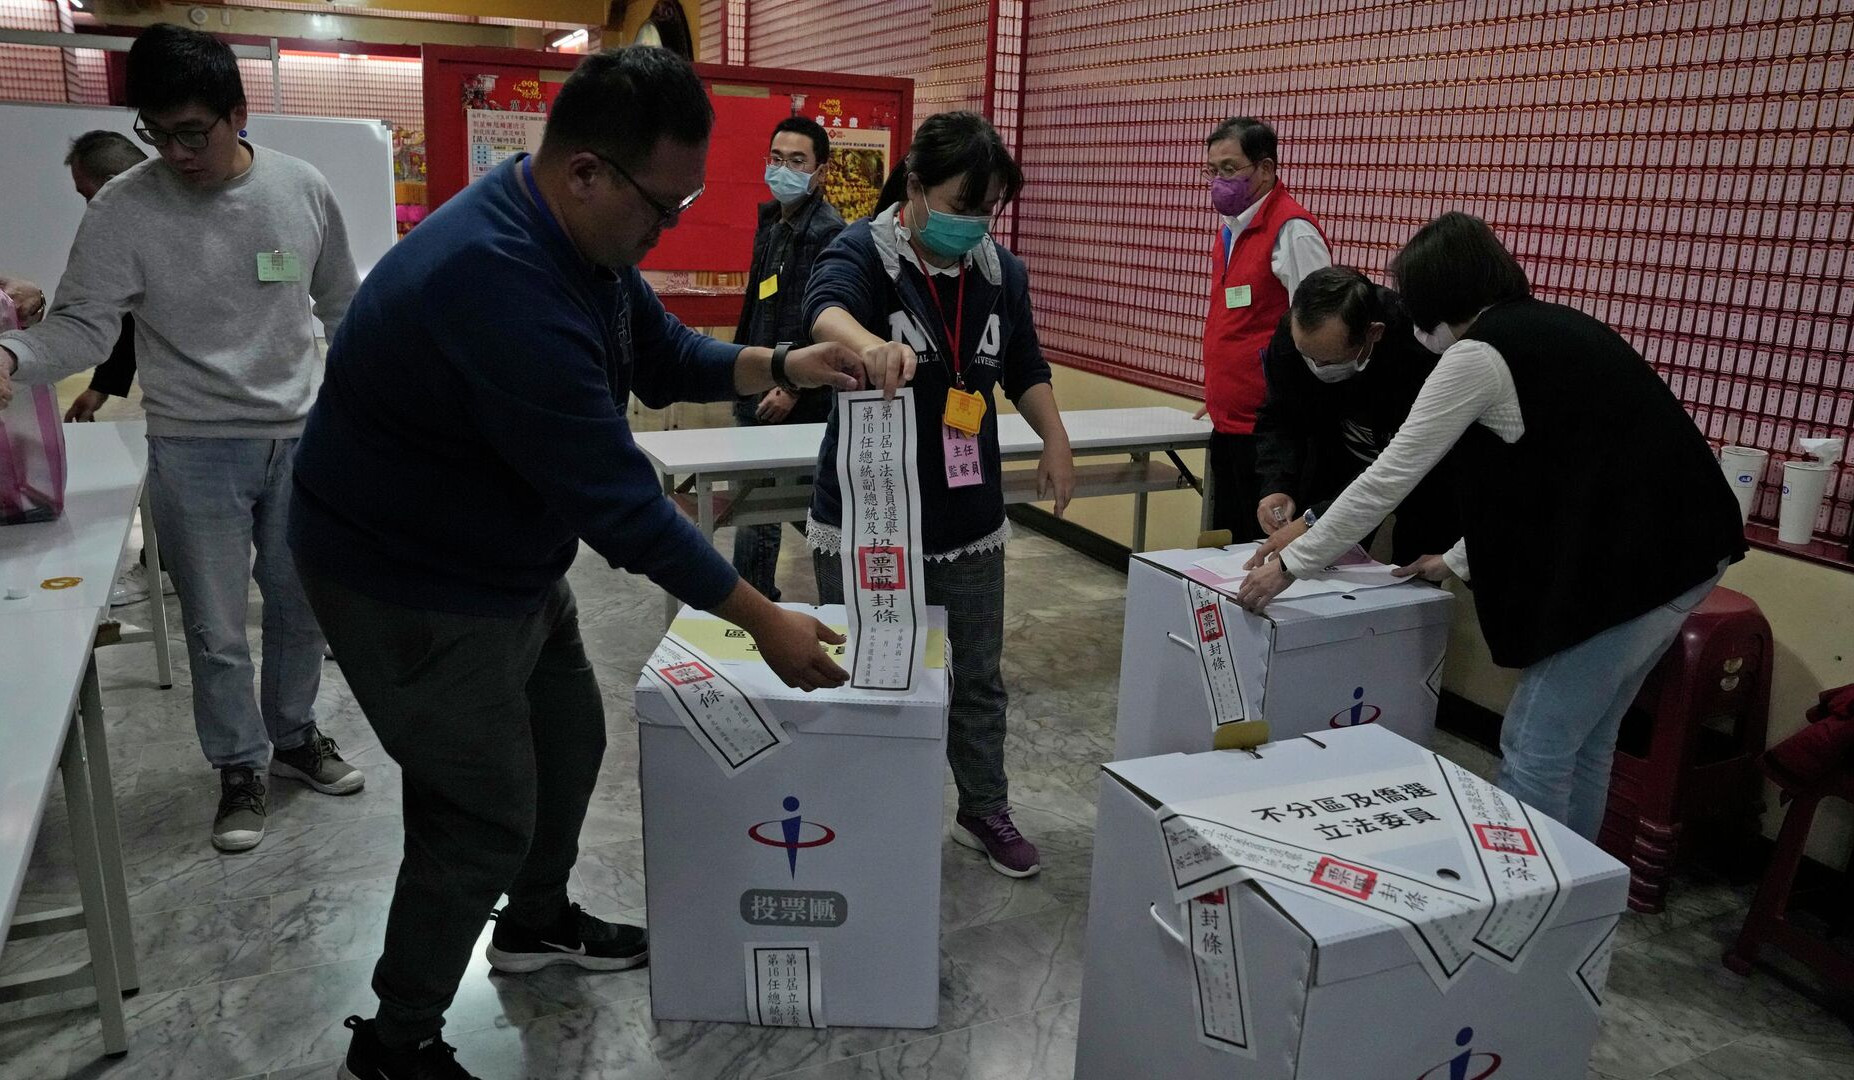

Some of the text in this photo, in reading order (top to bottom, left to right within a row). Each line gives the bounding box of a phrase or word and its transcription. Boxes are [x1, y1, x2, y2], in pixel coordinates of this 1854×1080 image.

[948, 461, 980, 478] 監察員
[953, 444, 973, 458] 主任
[858, 406, 880, 536] 第16任總統副總統及
[878, 405, 899, 536] 第11屆立法委員選舉
[1251, 781, 1438, 823] 不分區及僑選
[1314, 806, 1441, 841] 立法委員
